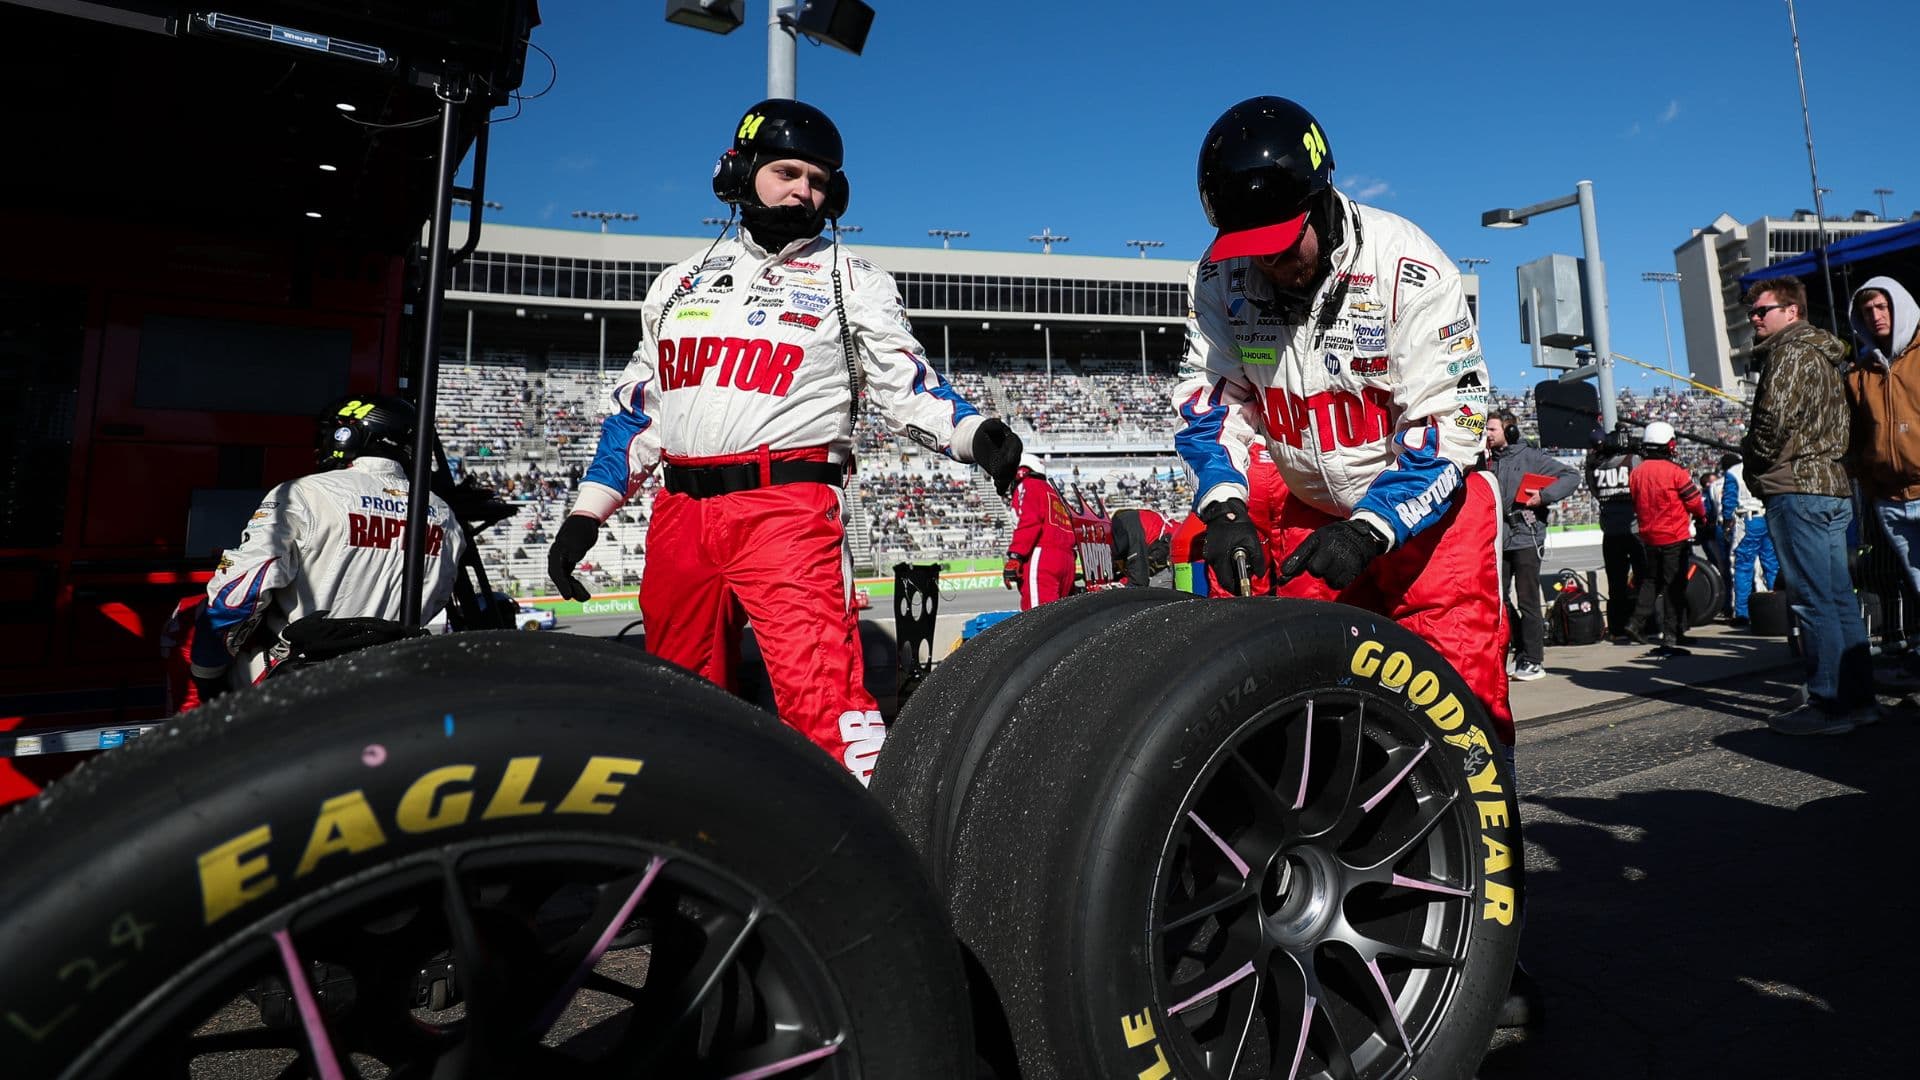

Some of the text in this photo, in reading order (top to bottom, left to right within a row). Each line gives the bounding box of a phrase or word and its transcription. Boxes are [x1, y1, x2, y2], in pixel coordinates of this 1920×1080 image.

[738, 114, 766, 139] 24
[1303, 122, 1327, 171] 24
[750, 310, 766, 326] hp
[1324, 342, 1354, 352] ENERGY
[1325, 335, 1354, 345] PHORM
[658, 337, 804, 397] RAPTOR
[1326, 352, 1340, 375] hp
[338, 400, 375, 419] 24
[1252, 384, 1393, 453] APTOR
[333, 450, 344, 459] 24
[361, 495, 437, 518] PROCR
[1395, 463, 1458, 529] RAPTOR
[939, 576, 997, 591] RESTART
[583, 599, 635, 614] EchoPark
[1350, 640, 1516, 926] GOODYEAR
[198, 756, 644, 925] EAGLE
